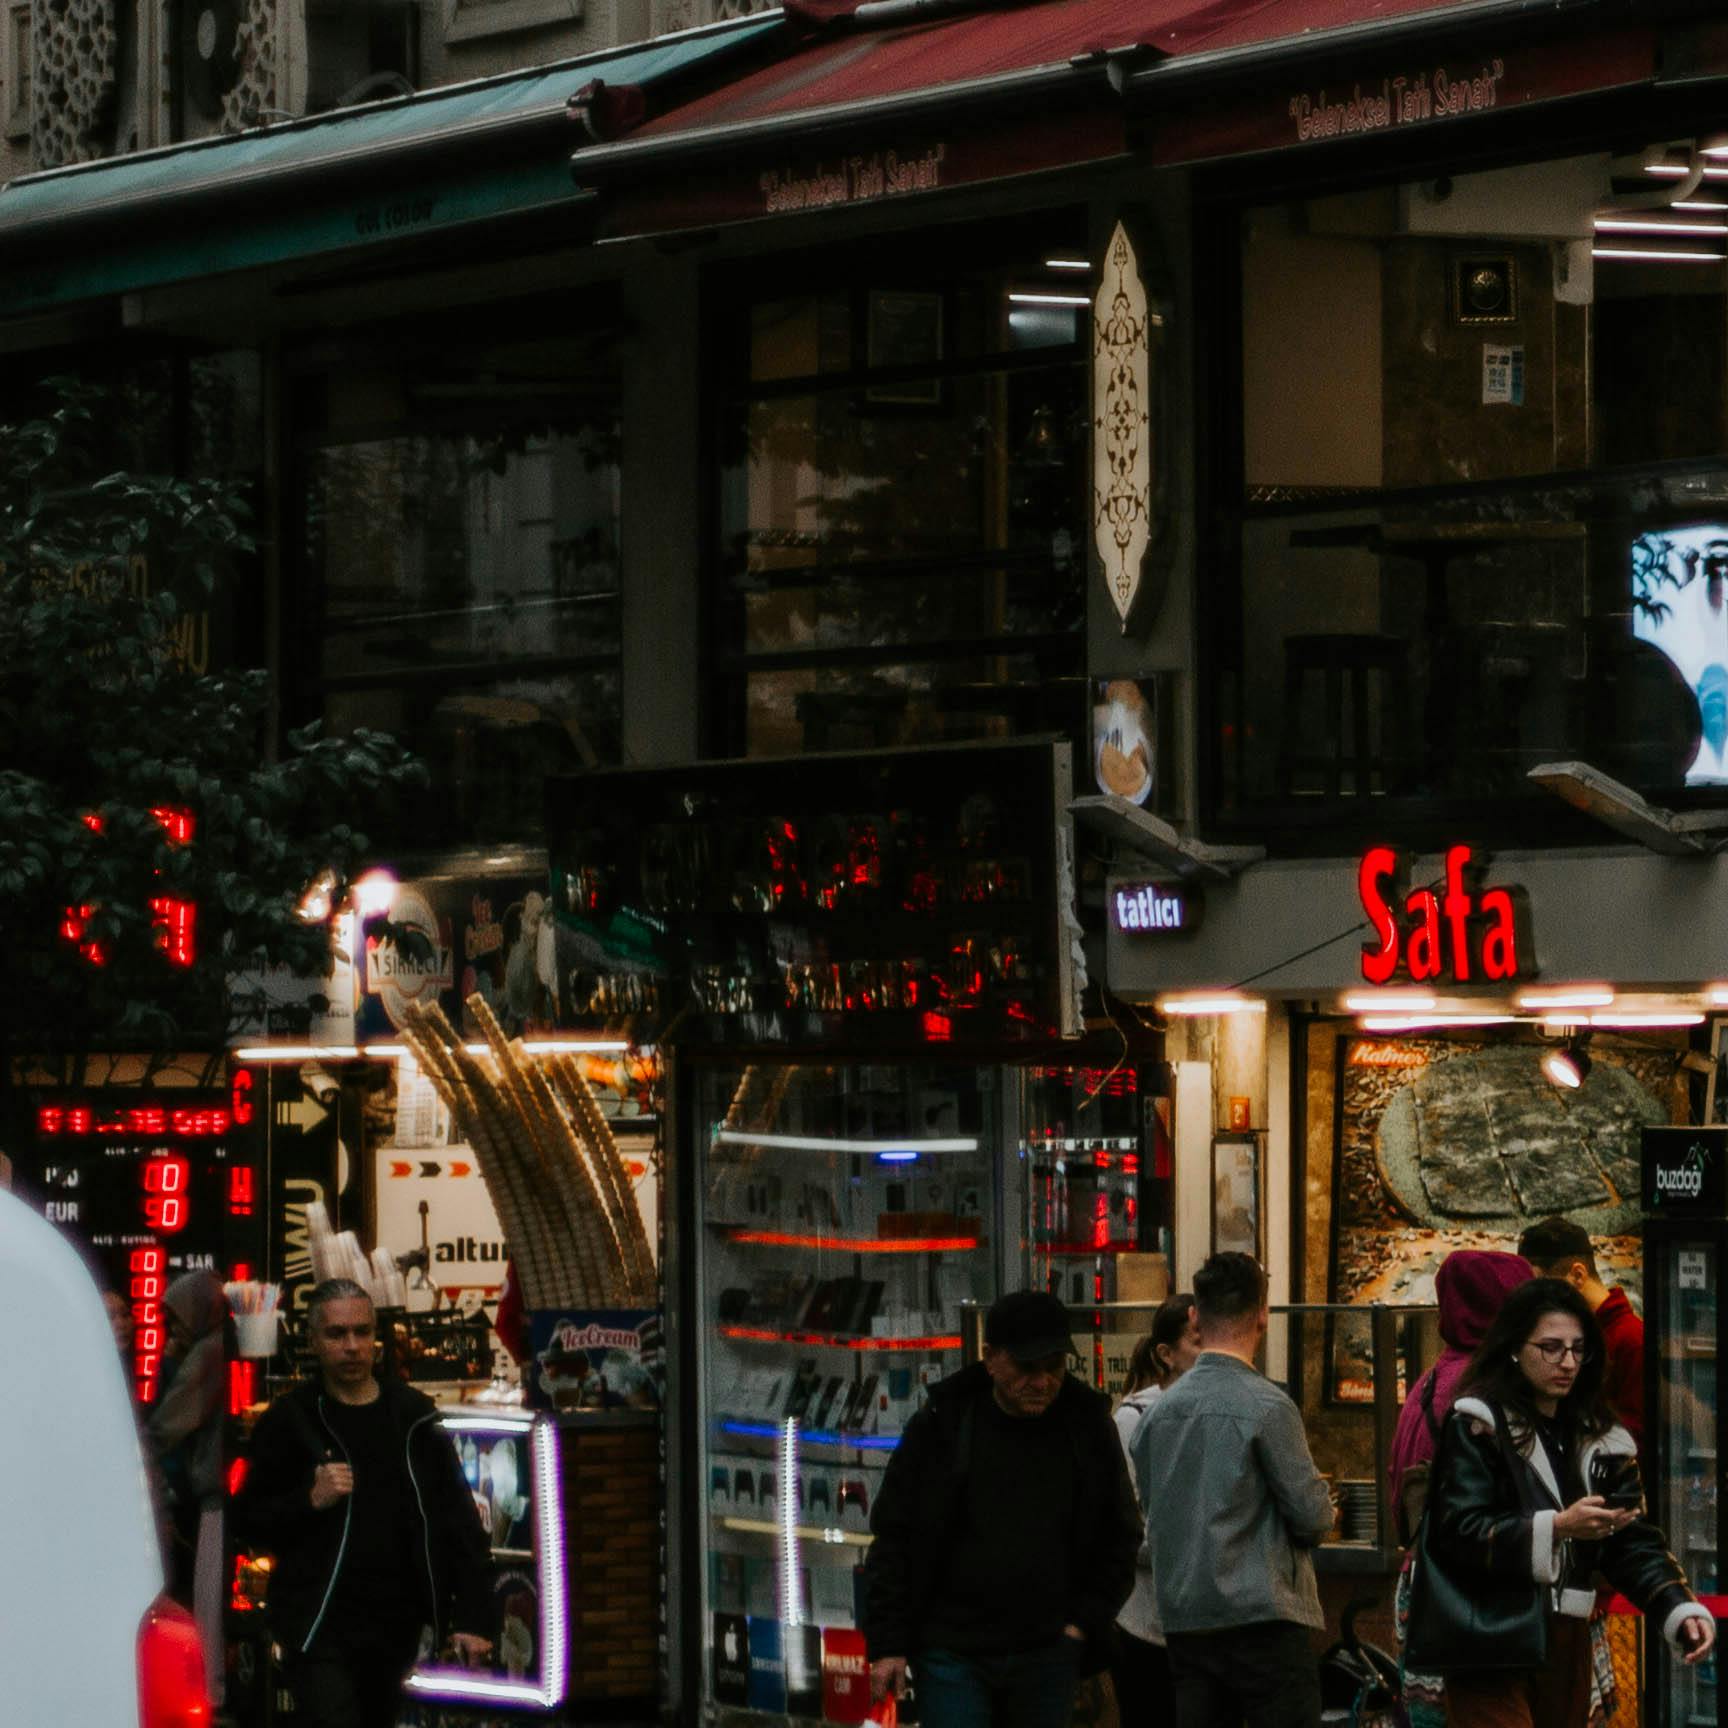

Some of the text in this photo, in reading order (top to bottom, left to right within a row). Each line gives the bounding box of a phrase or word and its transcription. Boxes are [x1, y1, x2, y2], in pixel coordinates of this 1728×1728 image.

[1117, 886, 1180, 928] tatlıcı
[1359, 845, 1519, 984] Safa
[1656, 1163, 1702, 1197] buzdağı
[46, 1202, 79, 1221] EUR
